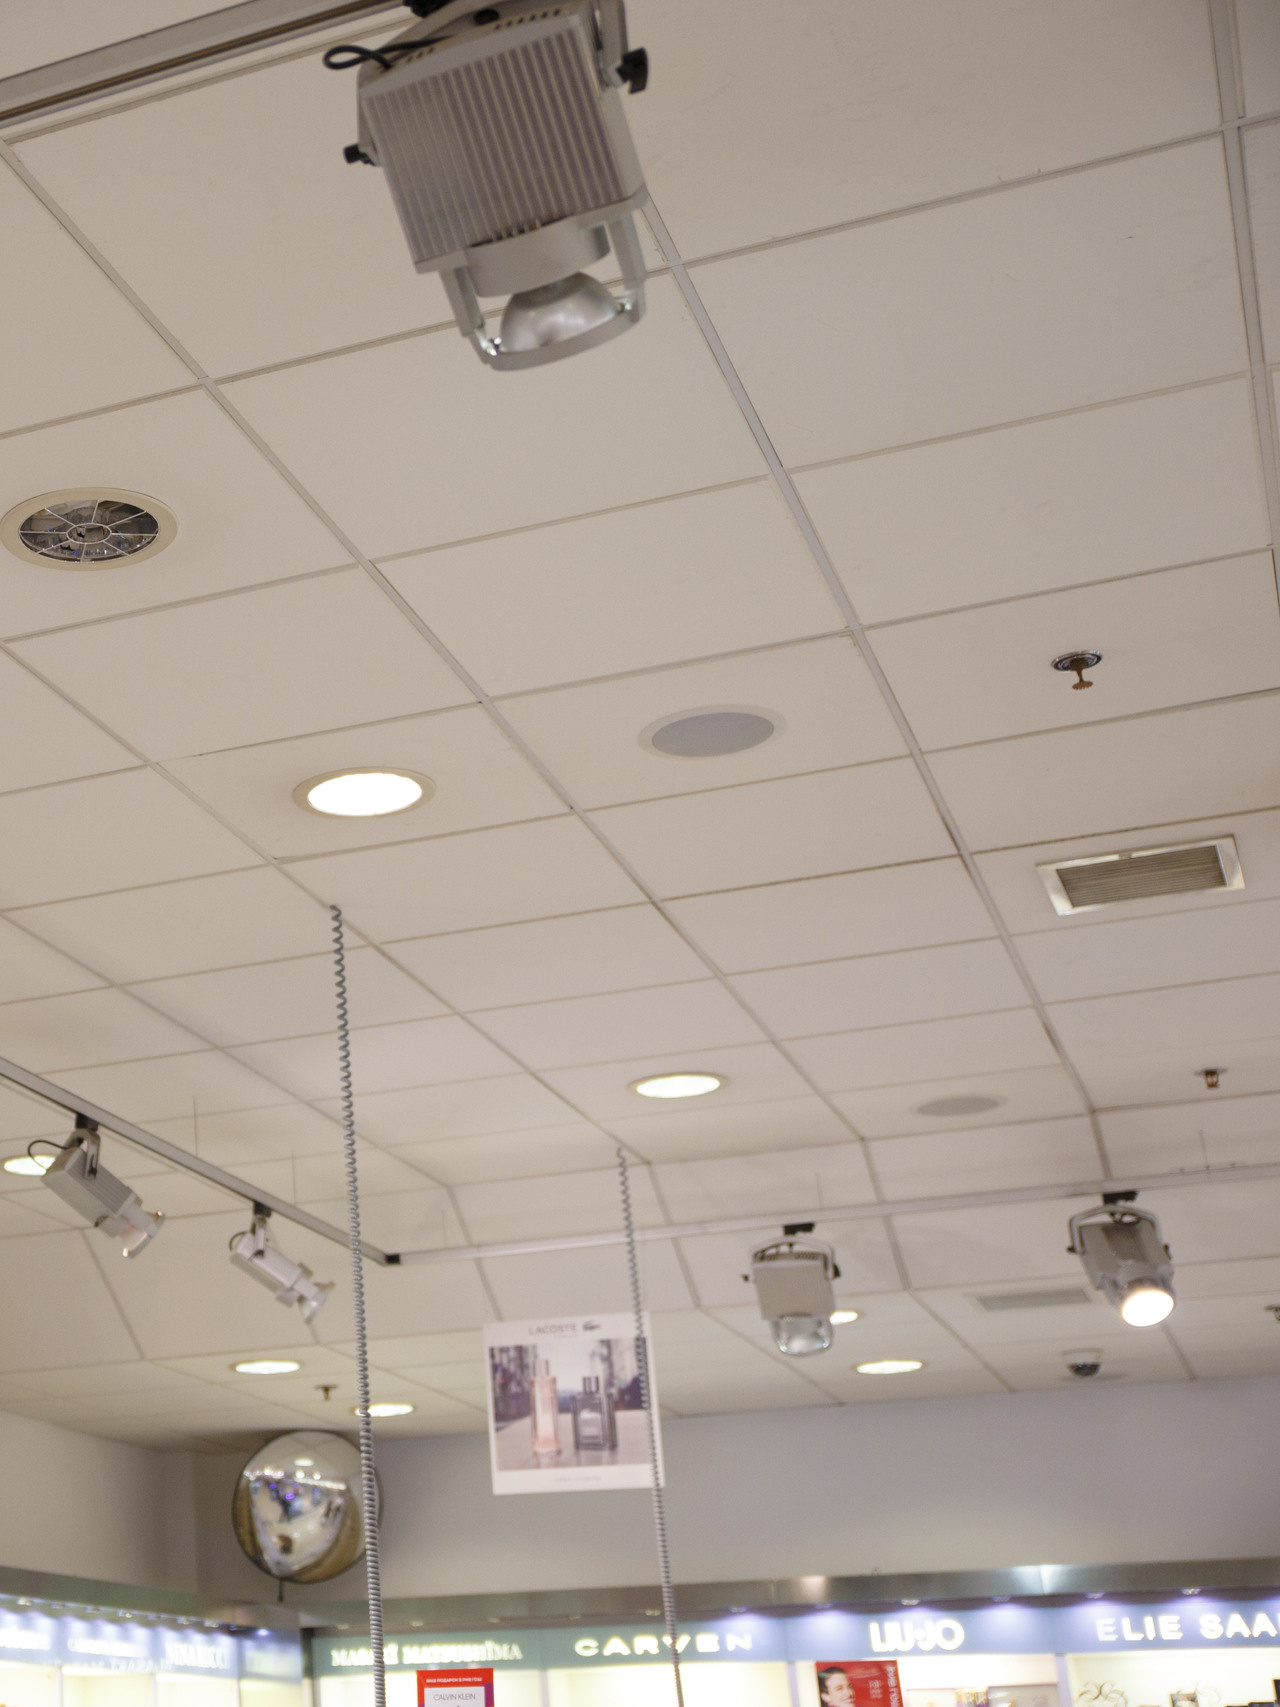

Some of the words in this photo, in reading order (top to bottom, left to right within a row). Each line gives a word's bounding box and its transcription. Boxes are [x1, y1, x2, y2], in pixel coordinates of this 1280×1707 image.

[527, 1322, 577, 1337] LACOSTE
[1095, 1614, 1184, 1641] ELIE
[1199, 1611, 1280, 1640] SAA
[574, 1633, 753, 1657] CARVEN
[433, 1693, 457, 1701] CALVIN
